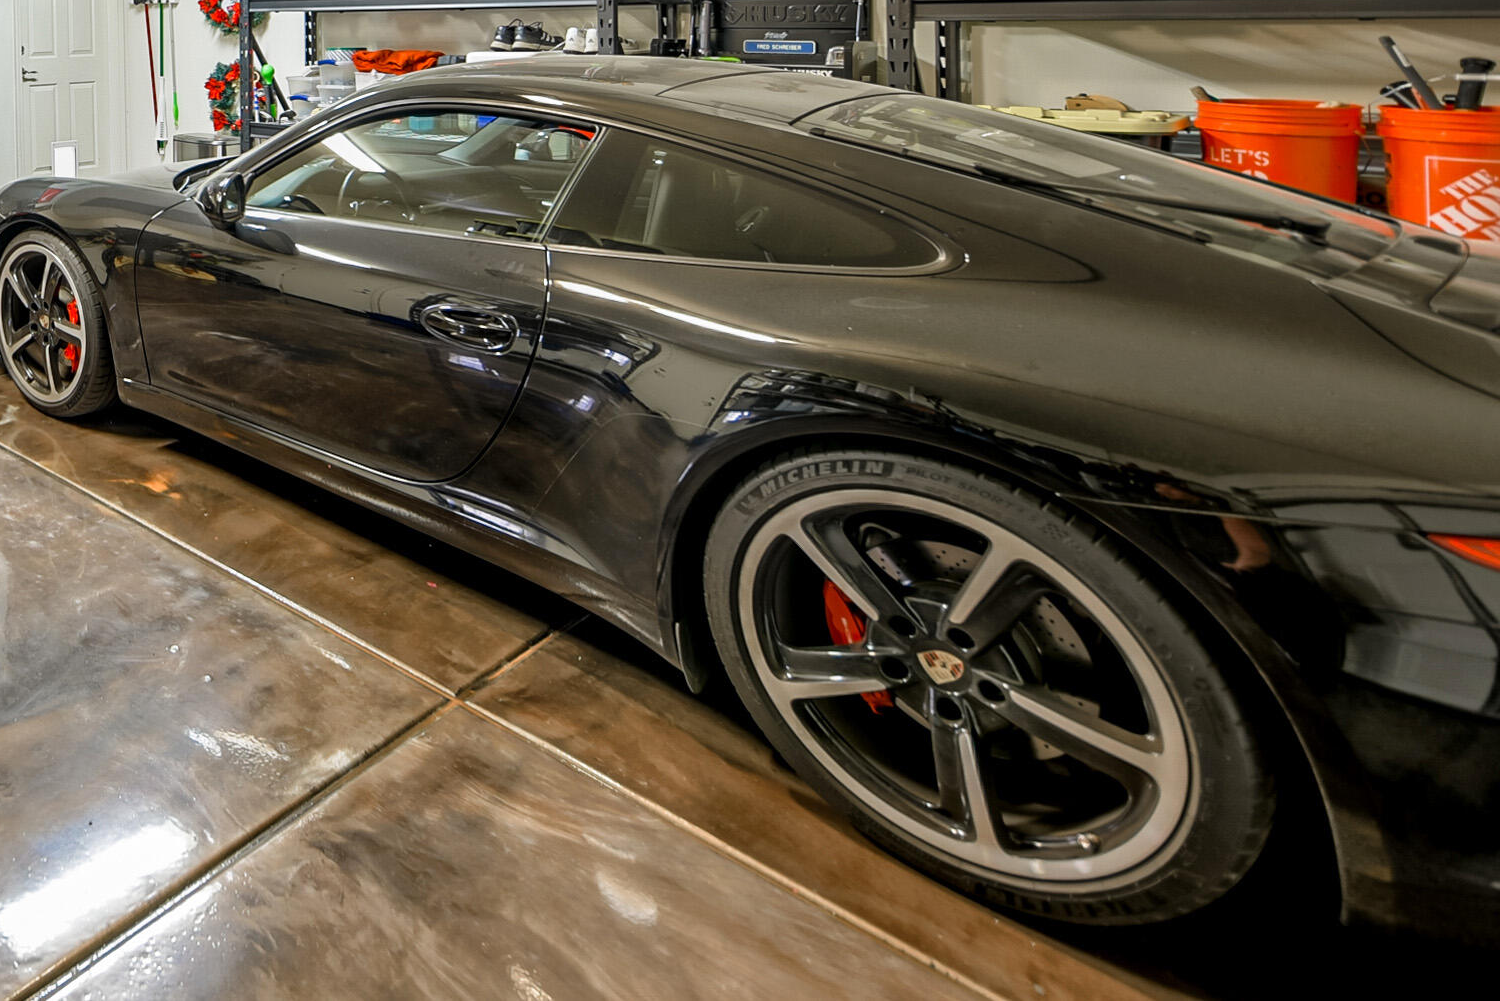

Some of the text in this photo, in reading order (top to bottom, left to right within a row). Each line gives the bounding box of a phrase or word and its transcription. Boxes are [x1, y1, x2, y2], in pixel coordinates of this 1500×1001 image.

[744, 4, 849, 23] HUSKY
[756, 43, 802, 51] FRED SCHREIBER
[1210, 146, 1270, 167] LET'S
[1439, 168, 1499, 200] THE
[759, 460, 885, 497] MICHELIN
[905, 466, 951, 484] PILOT
